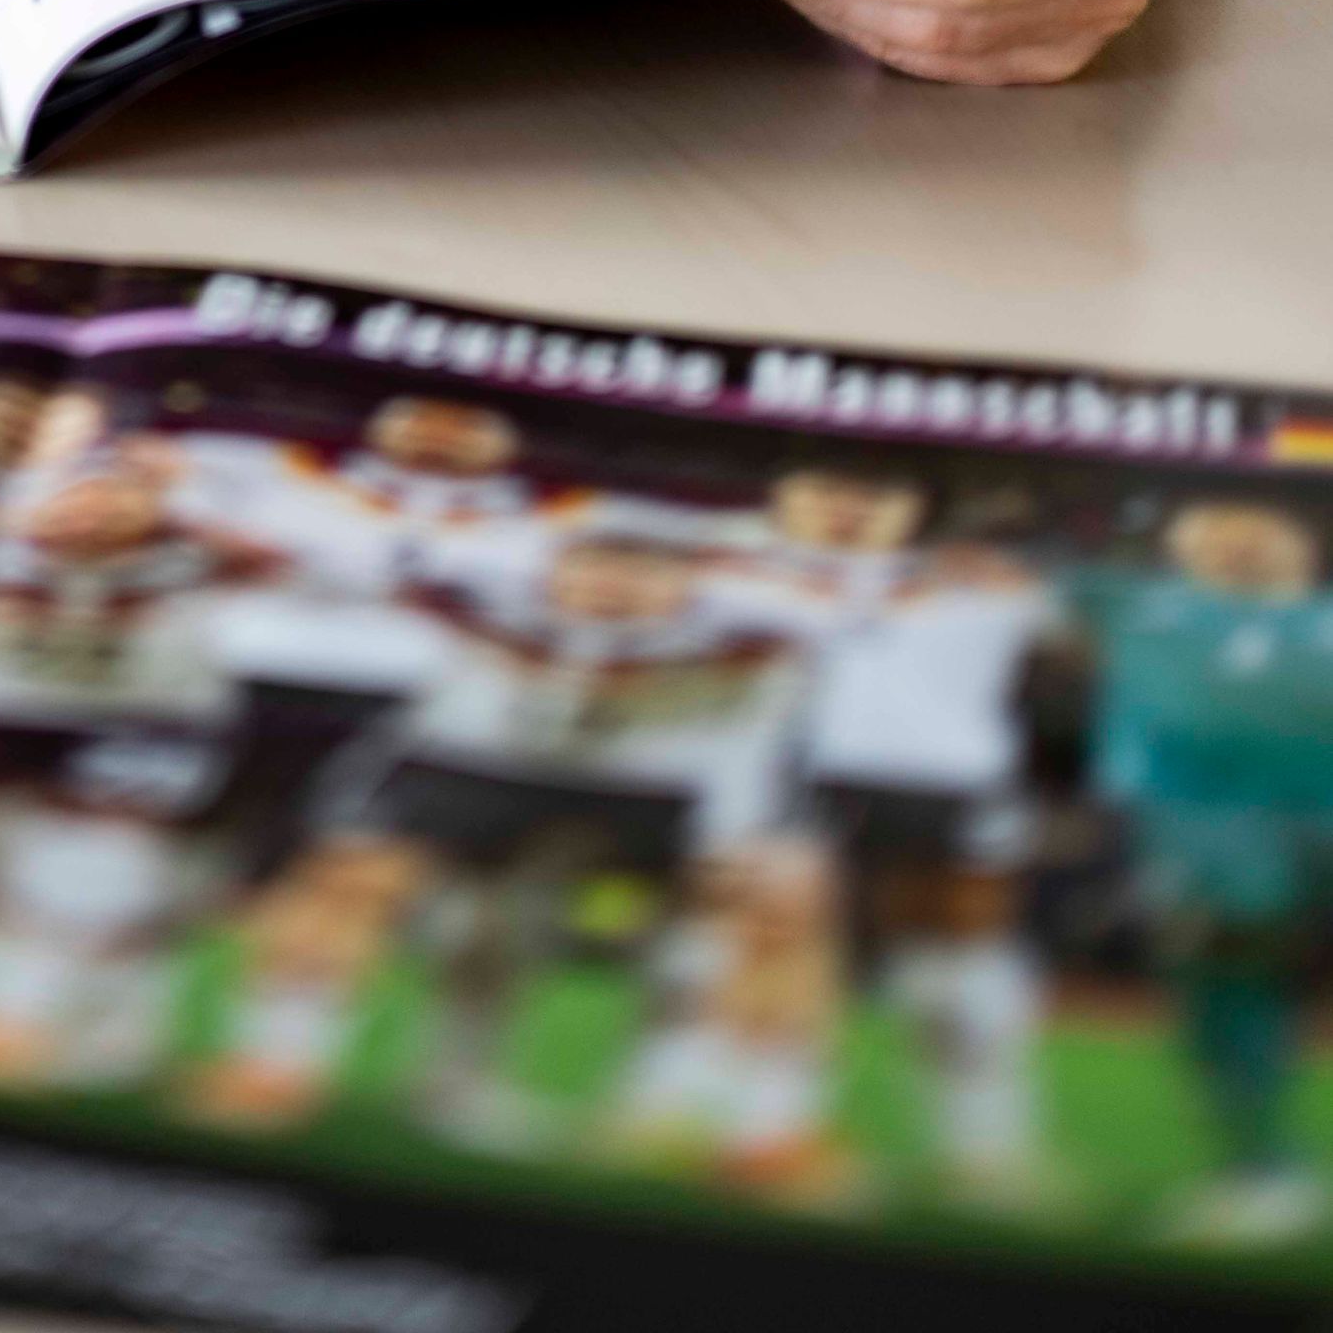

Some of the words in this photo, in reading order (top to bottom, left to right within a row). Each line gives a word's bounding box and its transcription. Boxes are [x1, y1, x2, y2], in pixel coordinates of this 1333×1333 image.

[198, 271, 333, 347] Die
[356, 300, 722, 407] deutsche
[751, 348, 1238, 457] Mannschaft
